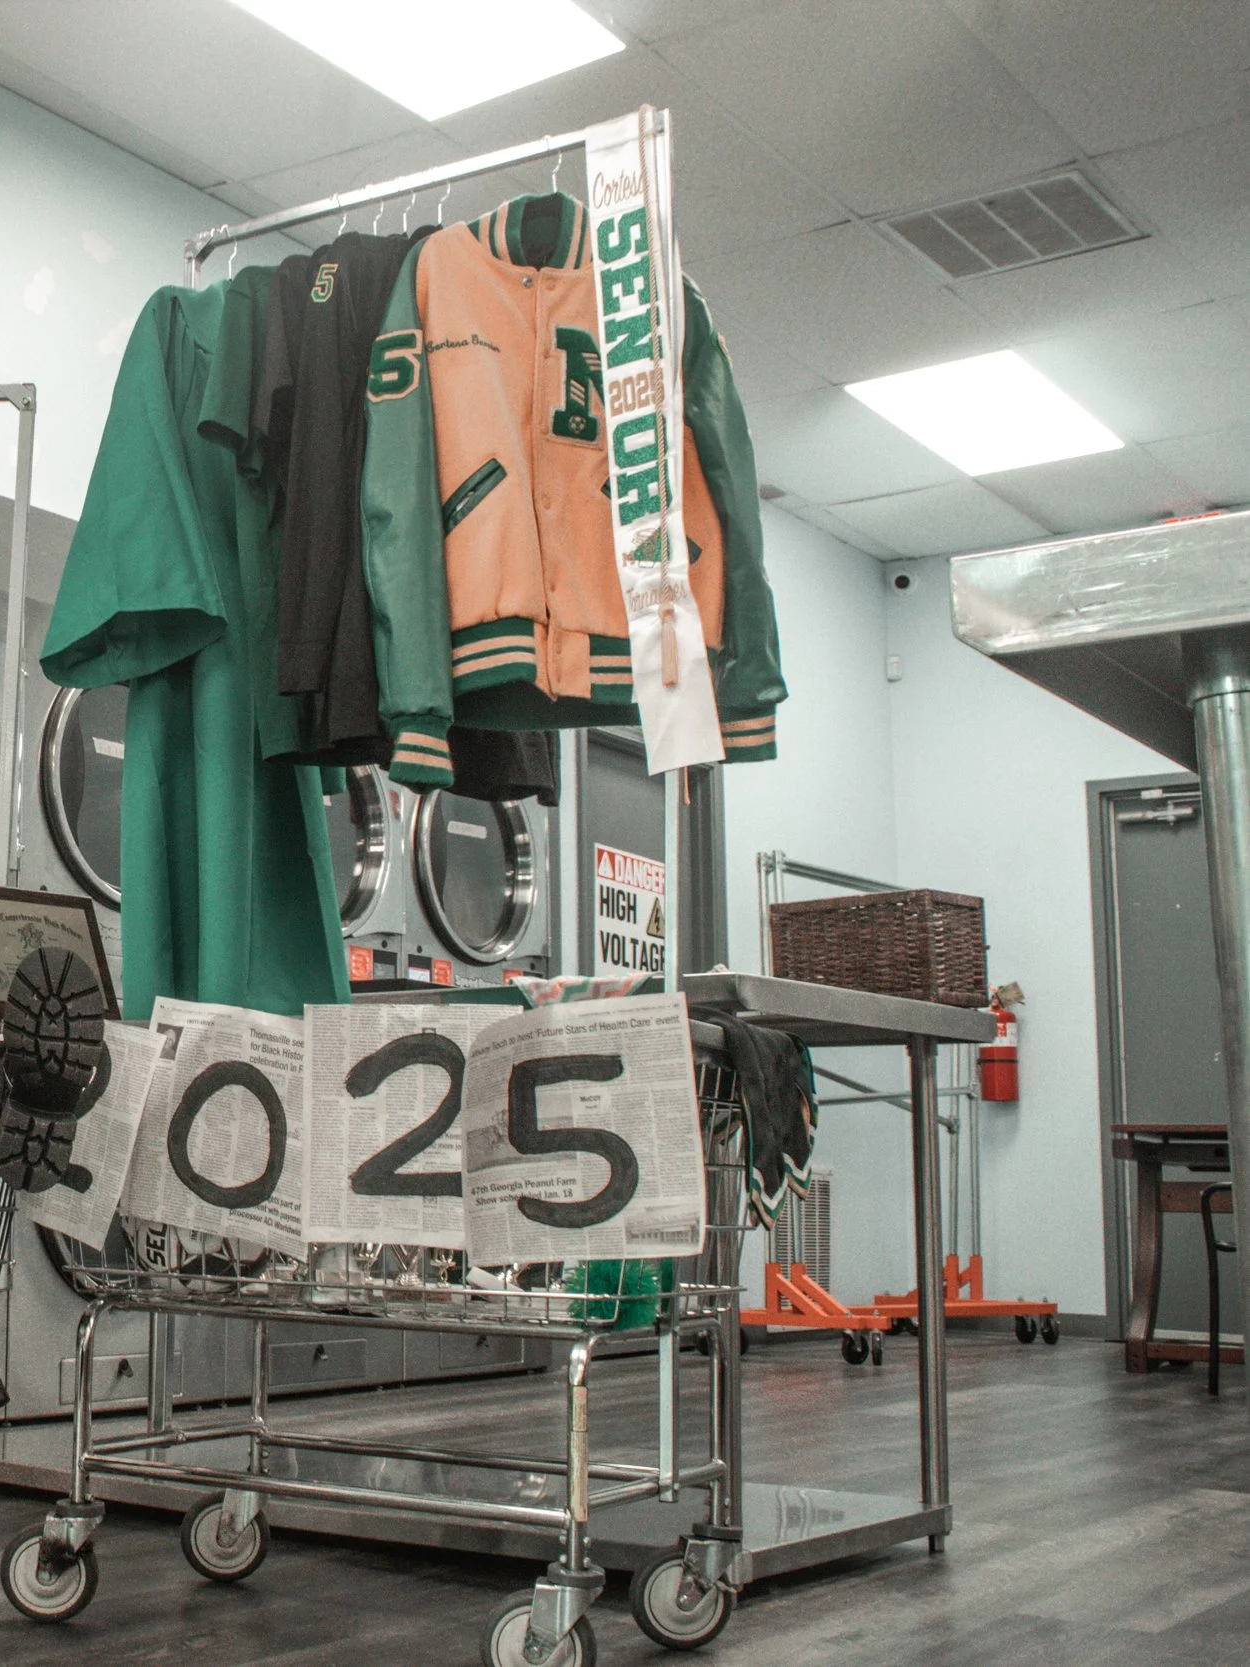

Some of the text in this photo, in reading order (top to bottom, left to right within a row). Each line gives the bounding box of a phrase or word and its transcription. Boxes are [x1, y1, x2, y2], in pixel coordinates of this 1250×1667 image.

[311, 264, 338, 302] 5
[366, 329, 423, 403] 5
[600, 885, 637, 924] HIGH
[565, 1024, 587, 1035] Stars
[589, 1022, 598, 1032] of
[599, 1019, 628, 1031] Health
[655, 1015, 680, 1026] event
[250, 1028, 291, 1046] Thomasville
[250, 1041, 261, 1051] for
[261, 1043, 281, 1056] Black
[250, 1055, 289, 1072] celebration
[290, 1063, 298, 1073] in
[490, 1181, 523, 1193] Georgia
[525, 1177, 555, 1189] Peanut
[556, 1176, 577, 1186] Farm
[476, 1196, 497, 1207] Show
